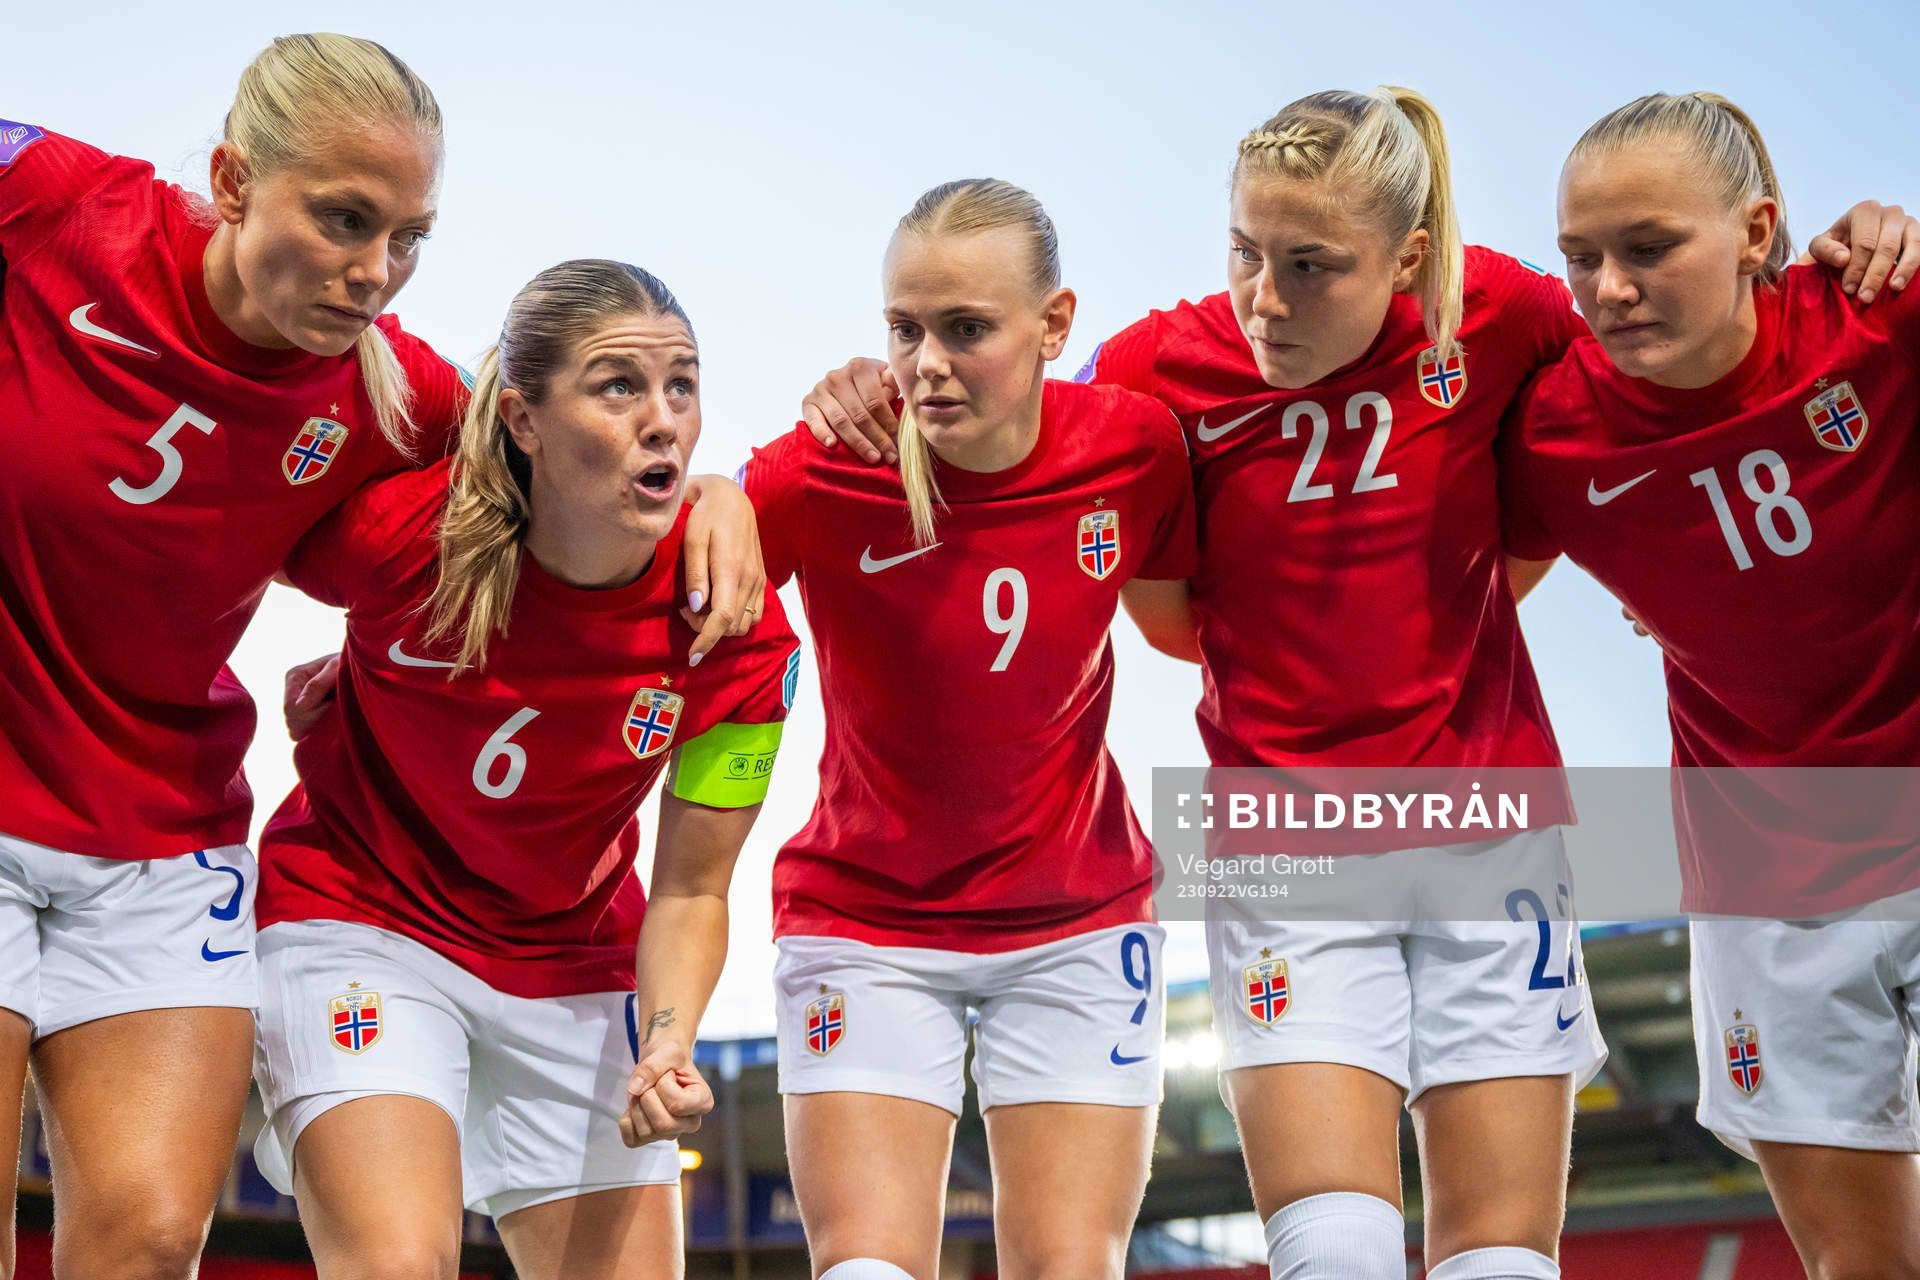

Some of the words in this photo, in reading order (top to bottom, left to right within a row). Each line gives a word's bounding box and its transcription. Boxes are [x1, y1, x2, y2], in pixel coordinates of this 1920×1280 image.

[108, 402, 217, 505] 5
[1281, 391, 1398, 503] 22
[1689, 449, 1813, 571] 18
[982, 567, 1029, 672] 9
[472, 706, 541, 799] 6
[1121, 932, 1151, 1025] 9
